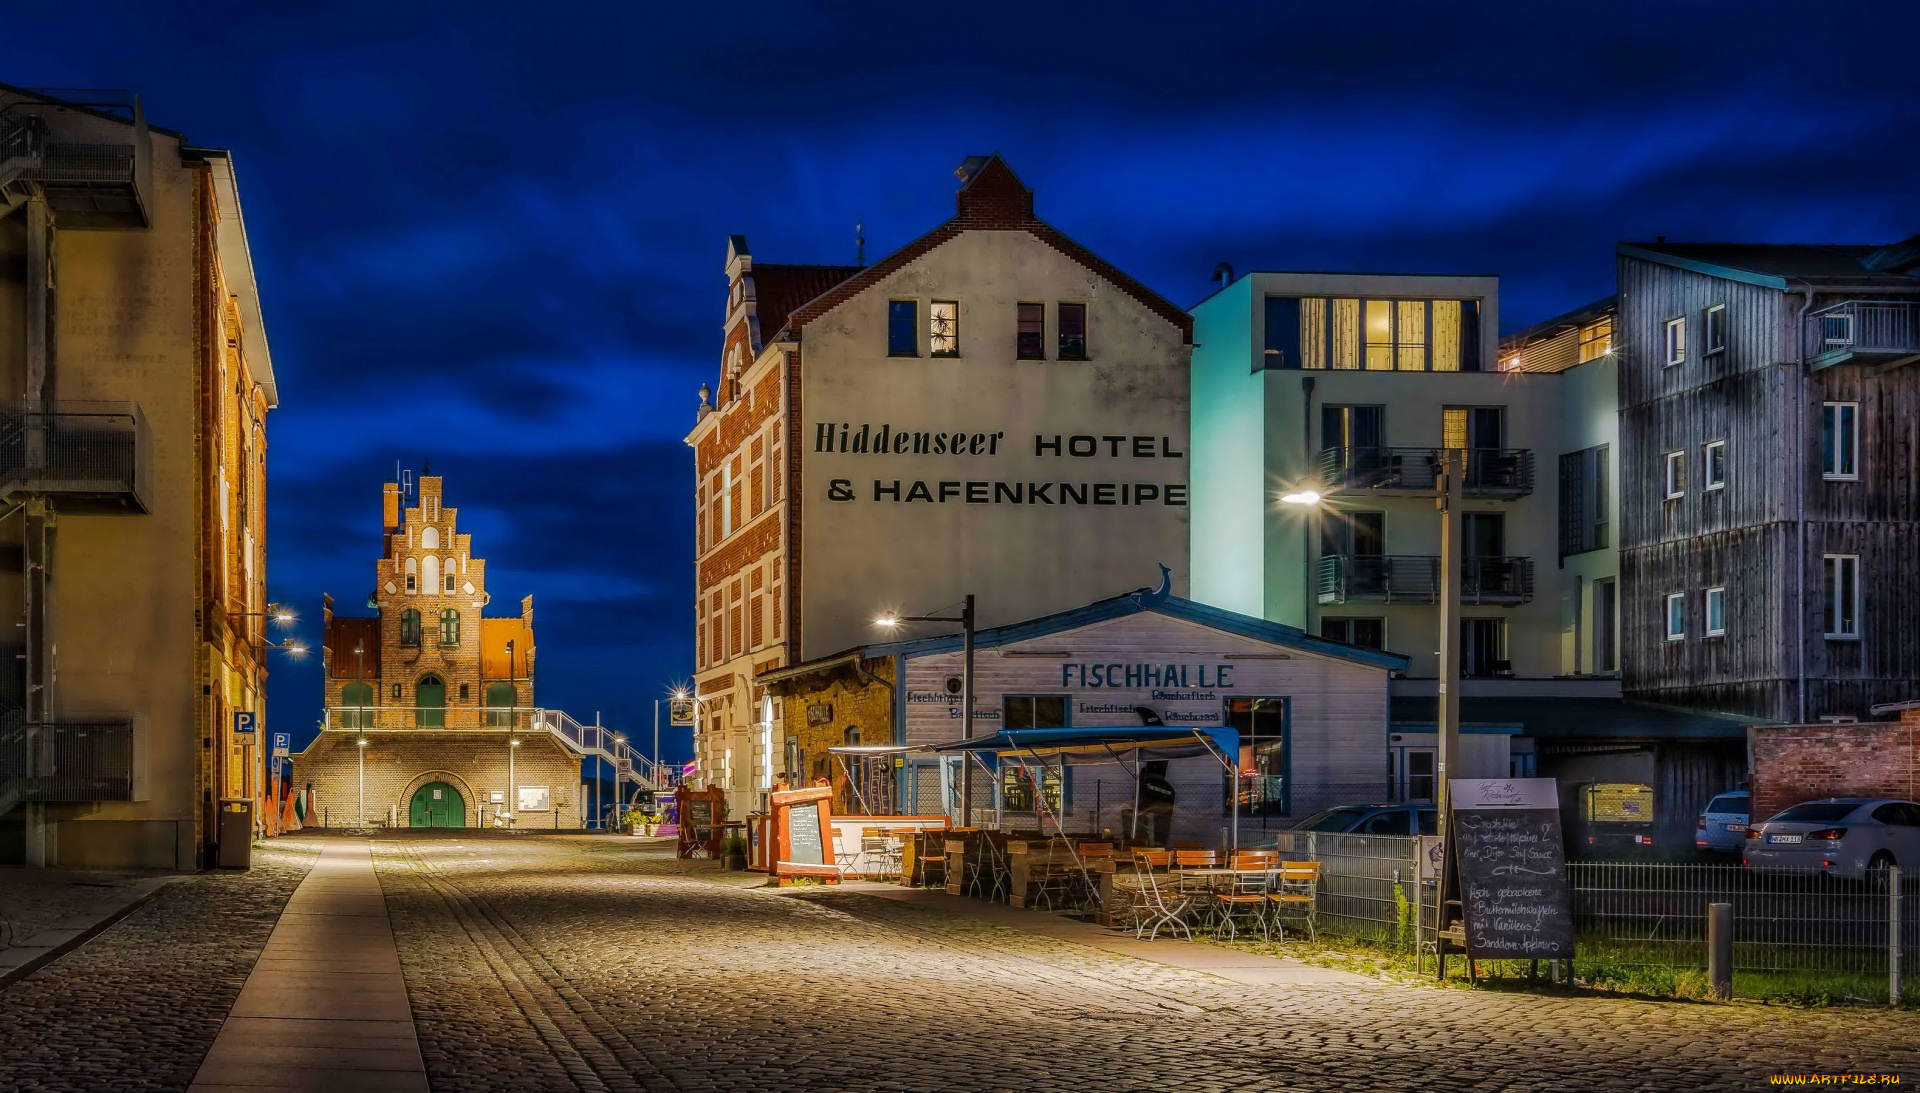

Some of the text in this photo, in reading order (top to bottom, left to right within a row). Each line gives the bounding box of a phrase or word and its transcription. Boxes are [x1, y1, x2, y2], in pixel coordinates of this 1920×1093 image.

[814, 422, 1183, 458] Hiddenseer HOTEL
[828, 479, 1187, 505] & HAFENKNEIPE
[1062, 663, 1234, 688] FISCHHALLE
[238, 714, 250, 730] P
[276, 735, 285, 746] P
